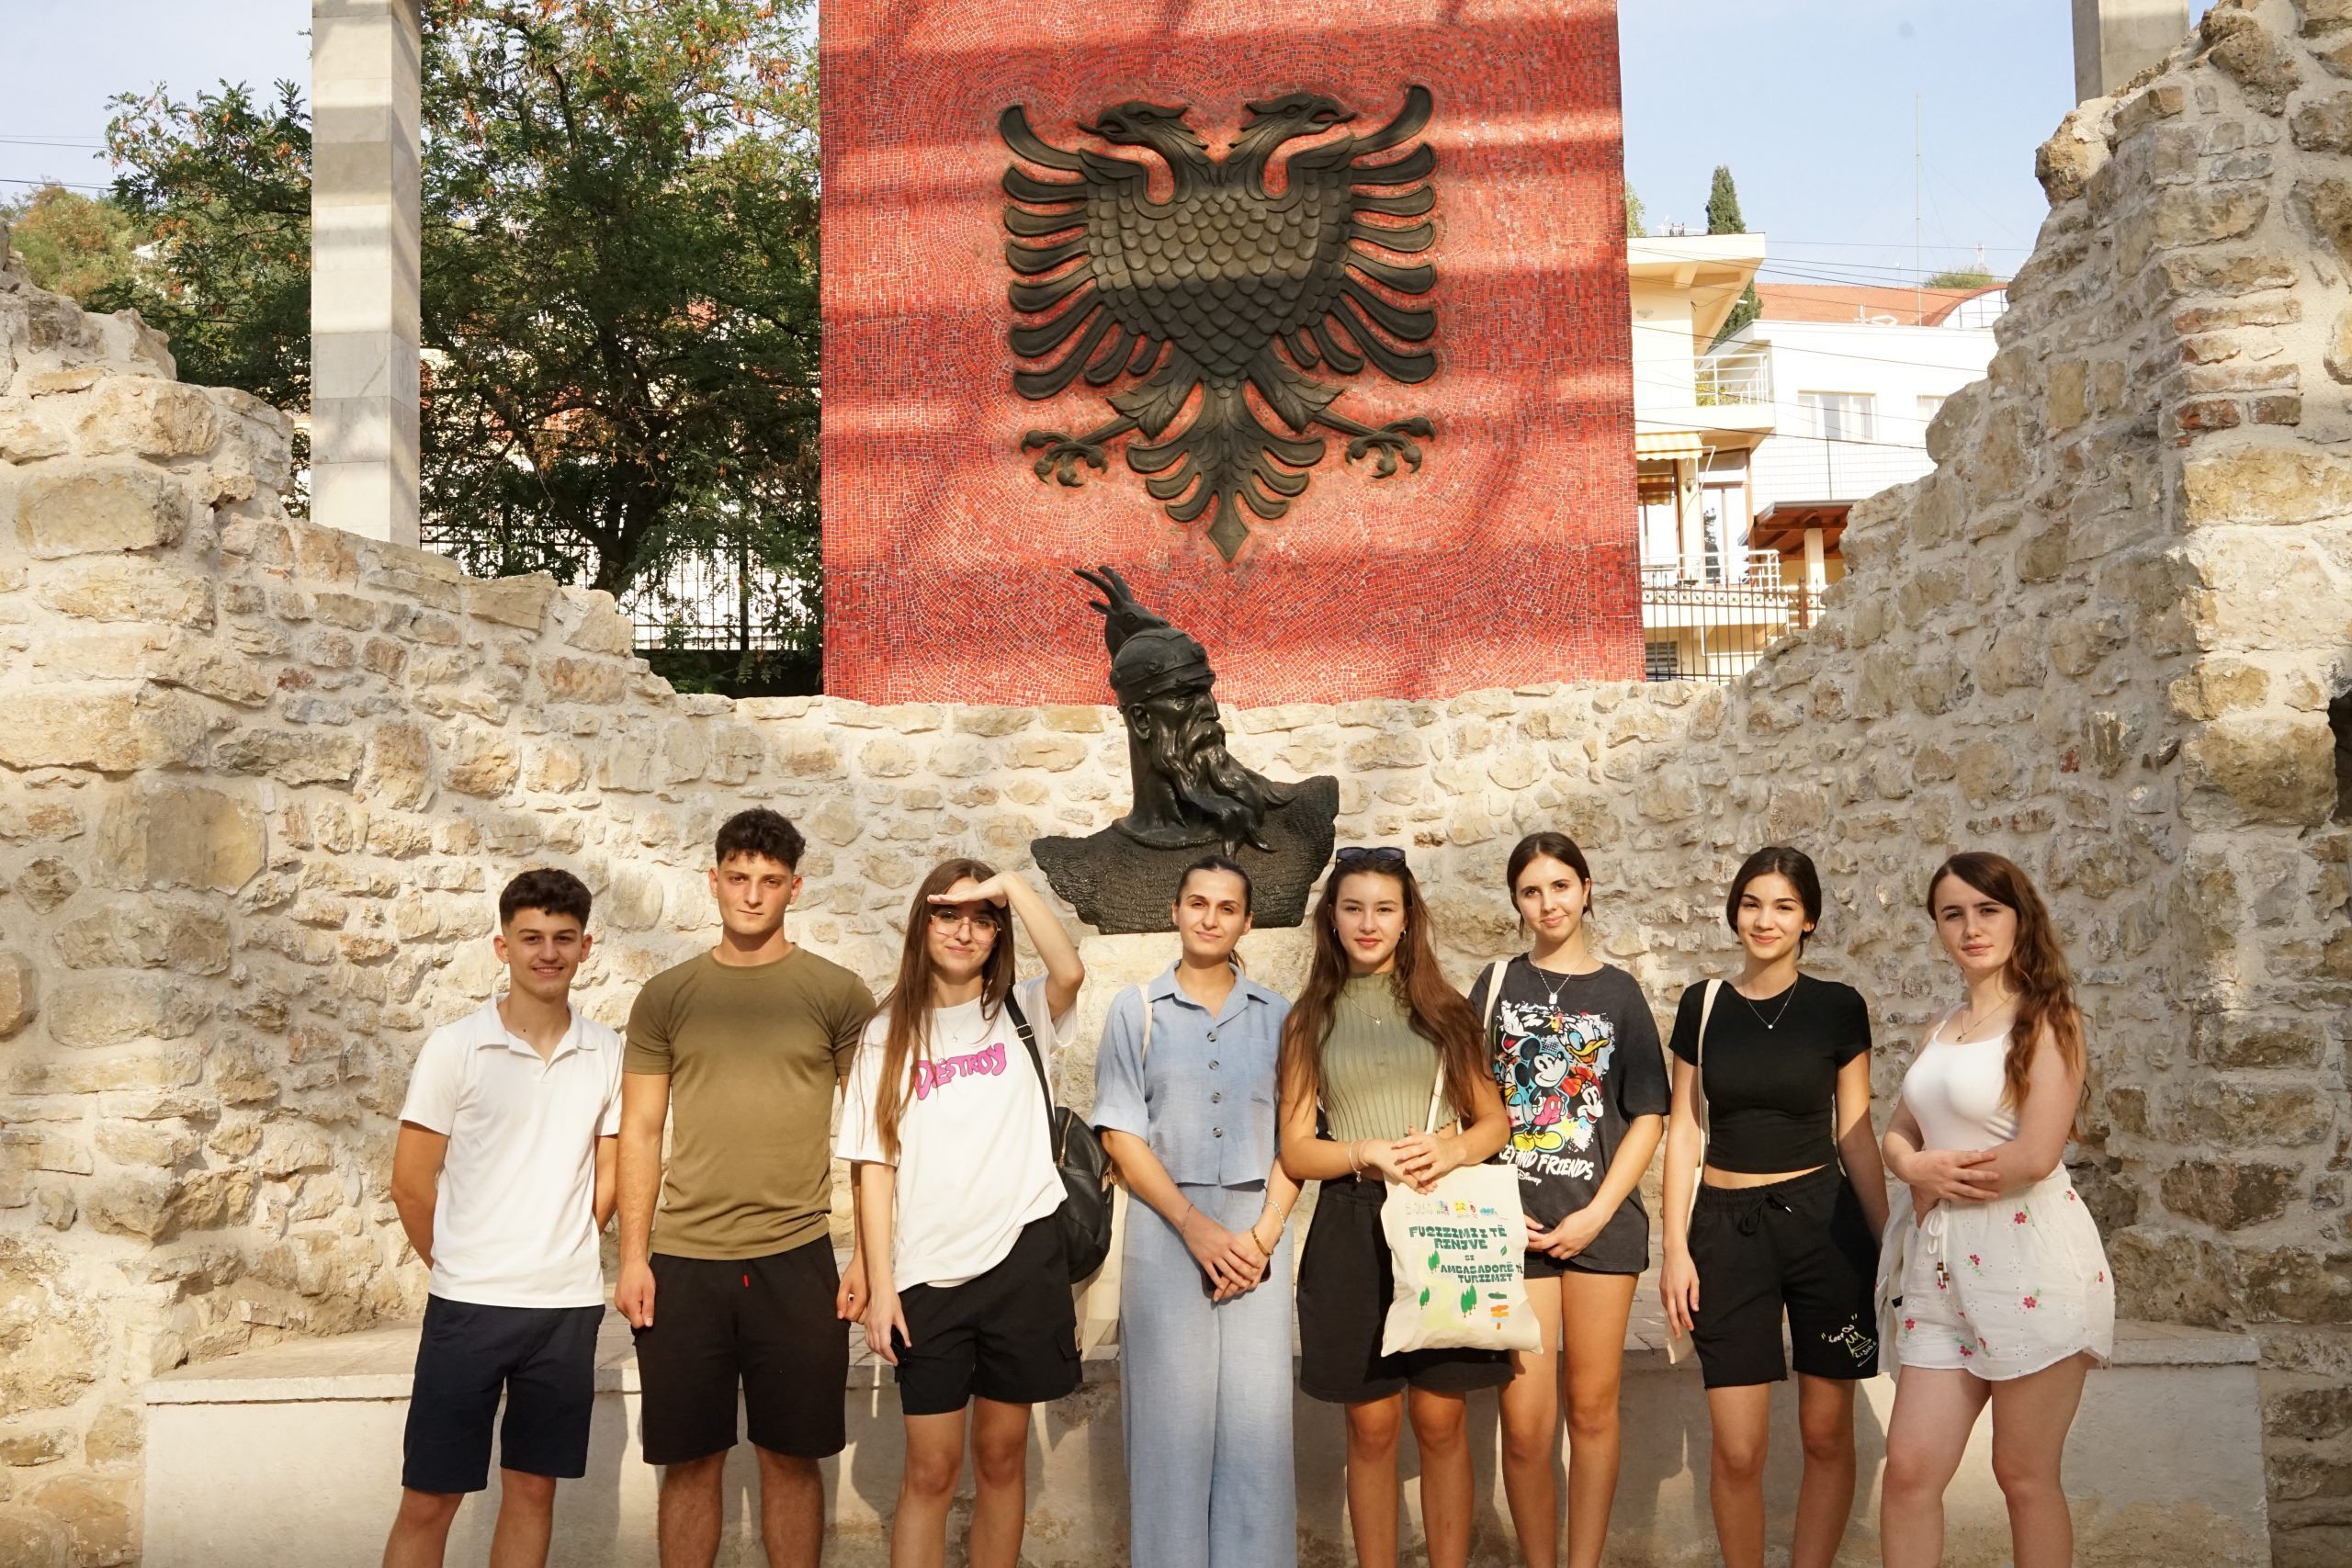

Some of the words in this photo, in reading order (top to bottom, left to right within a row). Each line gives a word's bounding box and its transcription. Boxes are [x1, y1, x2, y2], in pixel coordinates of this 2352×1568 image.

[910, 1043, 1007, 1100] DESTROY
[1517, 1169, 1542, 1186] Disney
[1537, 1154, 1594, 1180] FRIENDS
[1434, 1238, 1487, 1250] RINJVE
